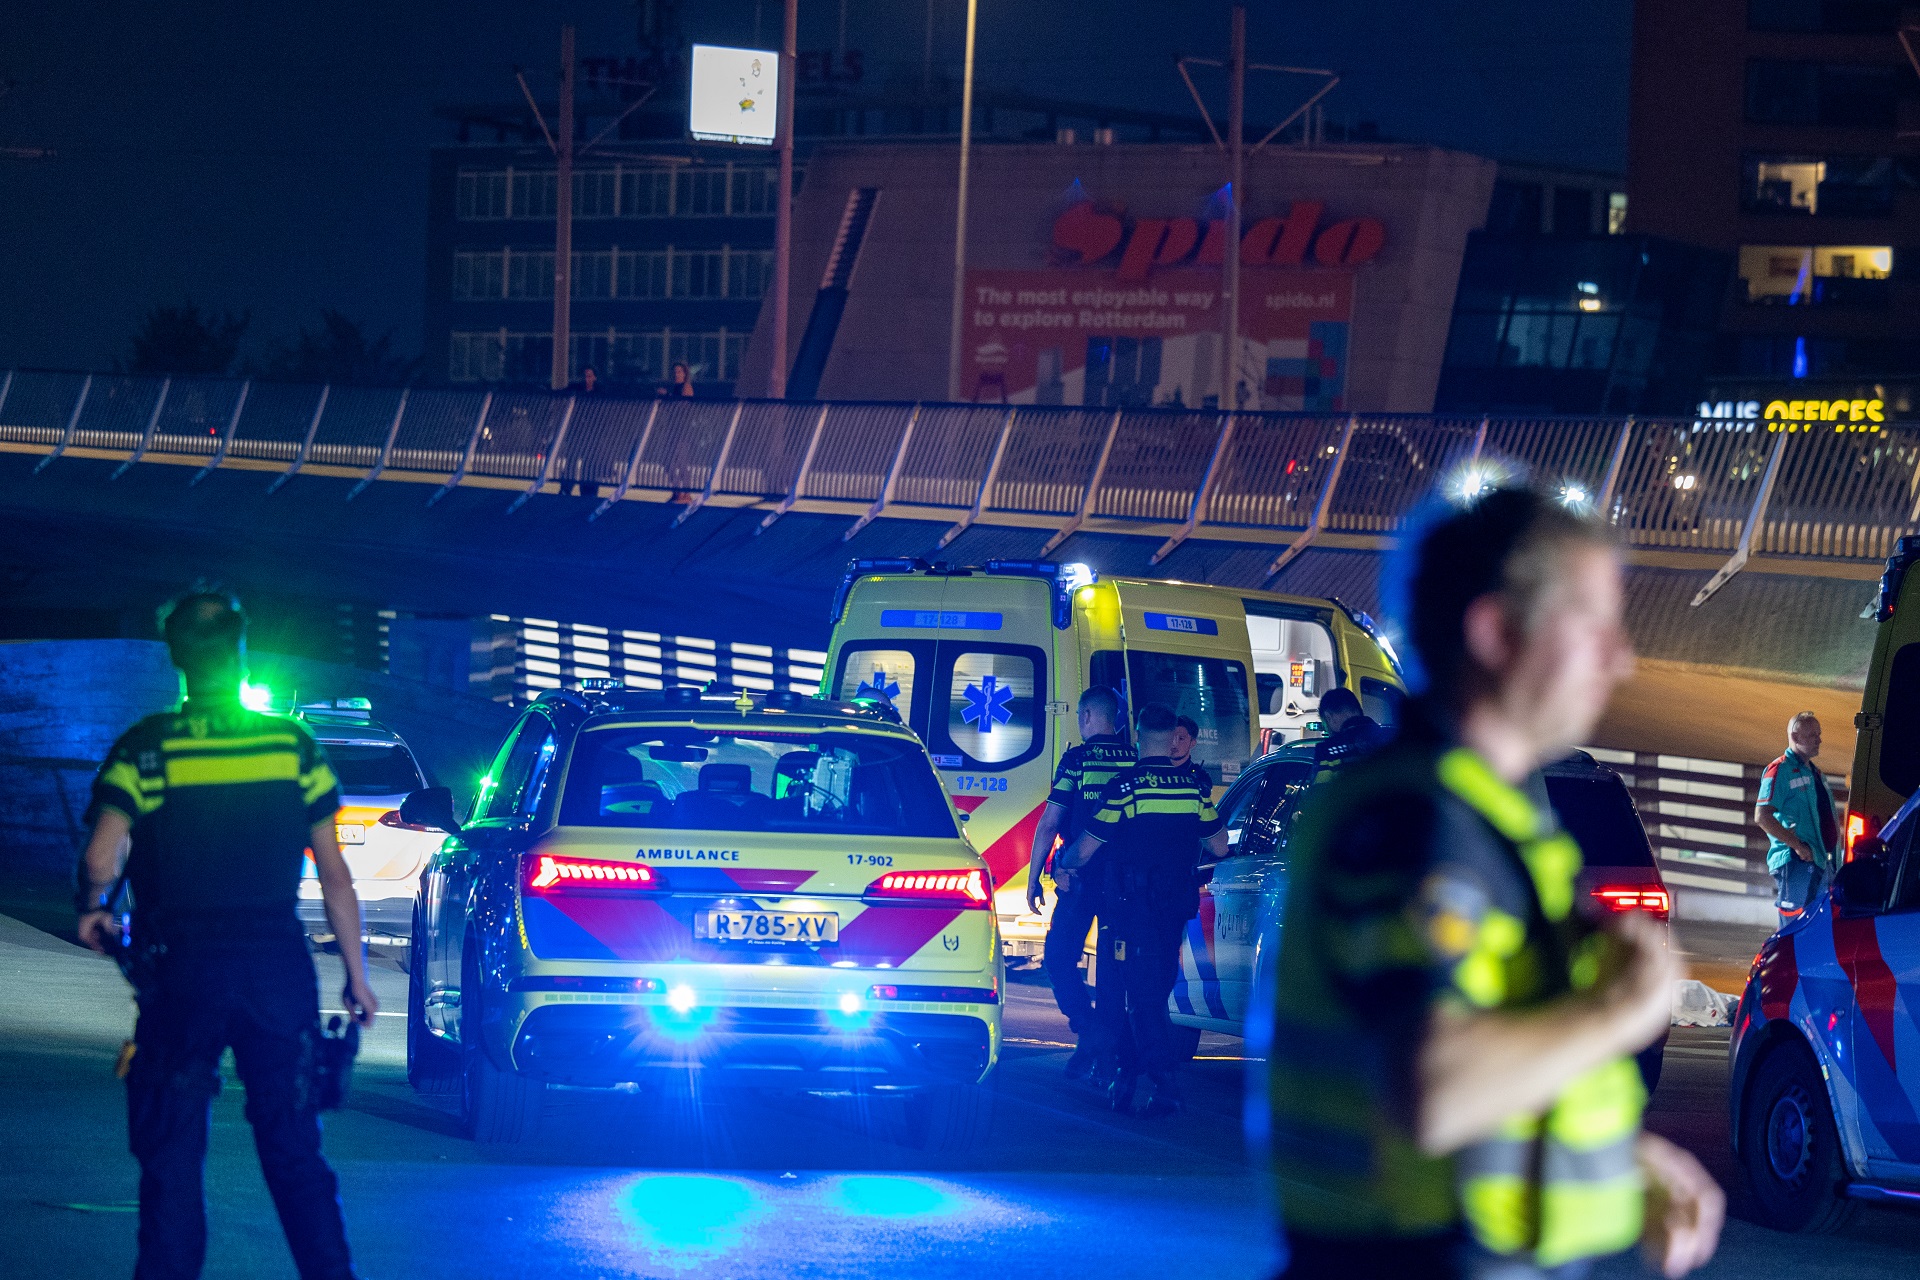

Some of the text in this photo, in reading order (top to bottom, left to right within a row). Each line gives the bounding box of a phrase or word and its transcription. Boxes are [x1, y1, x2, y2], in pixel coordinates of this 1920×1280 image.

[1053, 201, 1385, 279] Spido
[976, 287, 1215, 310] The most enjoyable way
[1265, 292, 1335, 309] spido.nl
[974, 310, 1186, 330] to explore Rotterdam
[1764, 399, 1885, 432] OFFICES
[922, 614, 958, 625] 17-128
[1170, 618, 1193, 630] 17-128
[956, 775, 1008, 792] 17-128
[1083, 791, 1102, 800] HON
[635, 848, 740, 861] AMBULANCE
[847, 854, 894, 867] 17-902
[716, 914, 828, 937] R-785-XV
